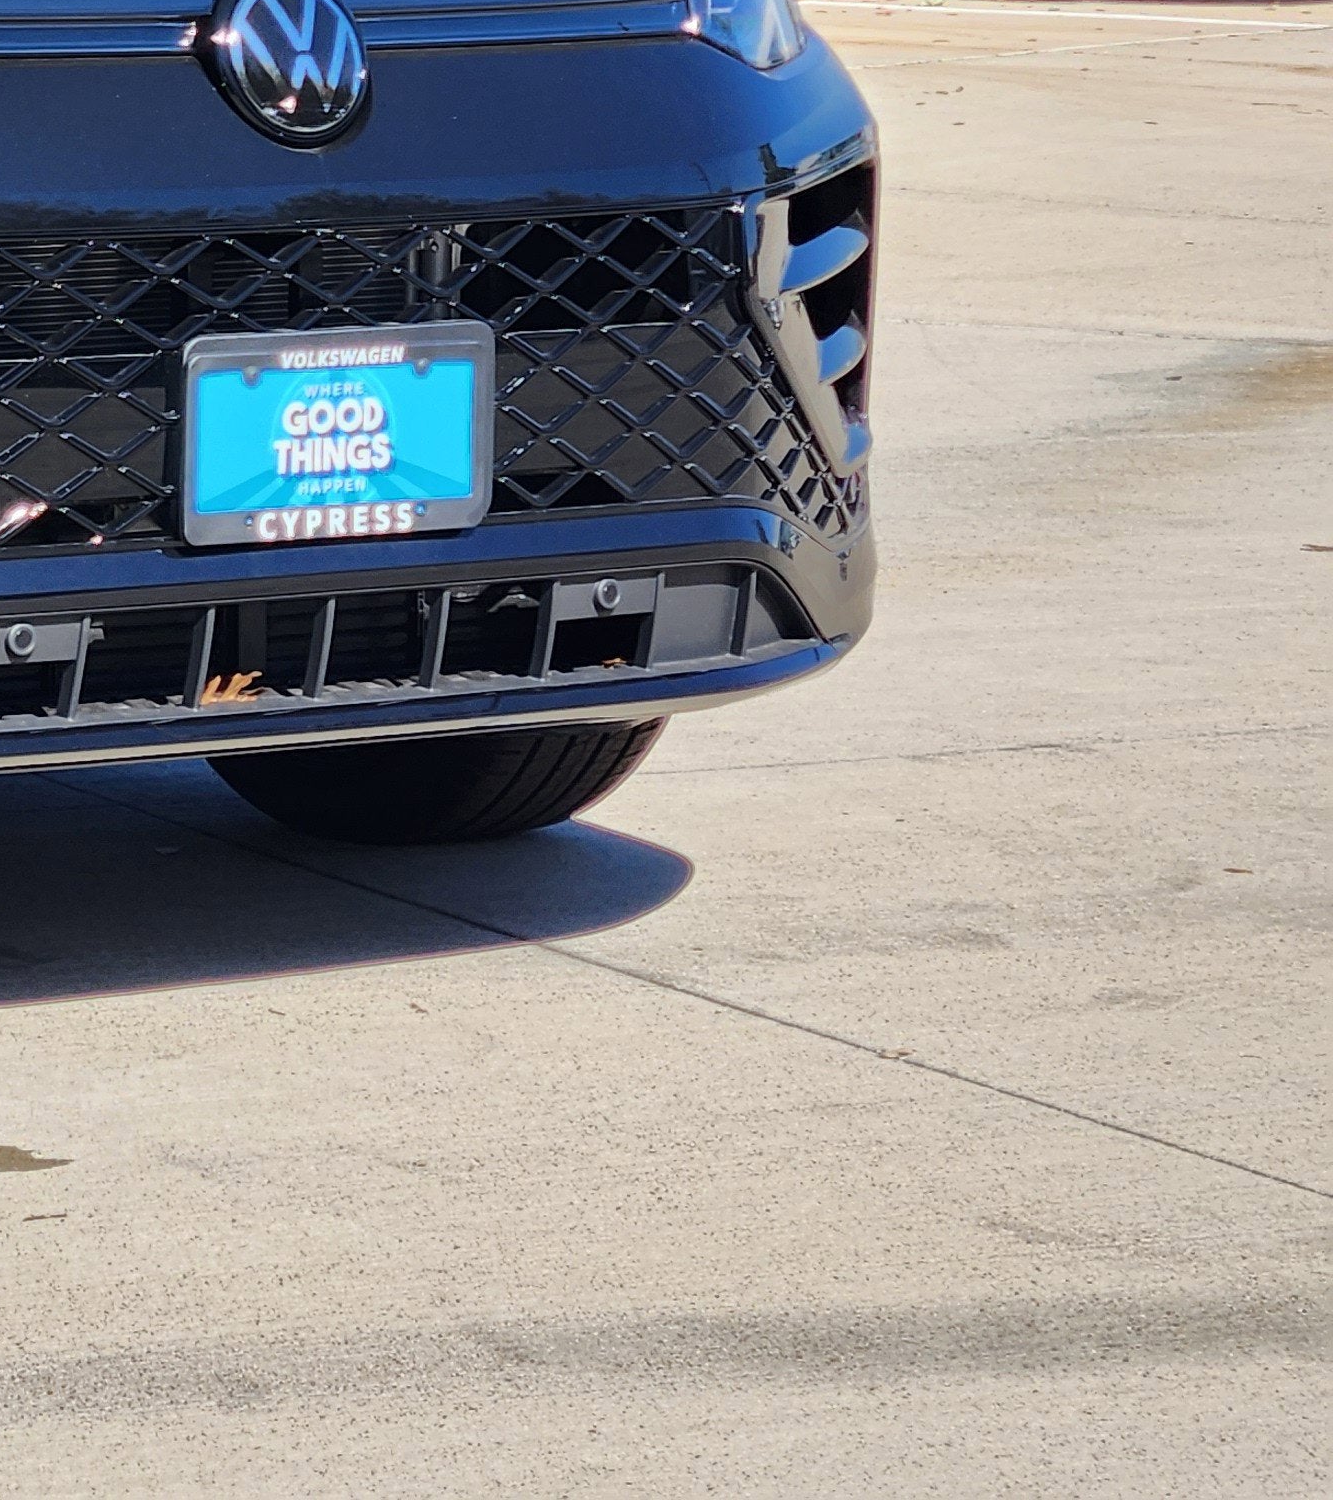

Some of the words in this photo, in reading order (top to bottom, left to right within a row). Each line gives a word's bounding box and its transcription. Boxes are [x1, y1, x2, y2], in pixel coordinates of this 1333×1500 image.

[280, 346, 405, 369] VOLKSWAGEN
[305, 382, 365, 398] WHERE
[284, 398, 384, 436] GOOD
[273, 435, 392, 475] THINGS
[296, 477, 367, 496] HAPPEN
[259, 503, 413, 540] CYPRESS
